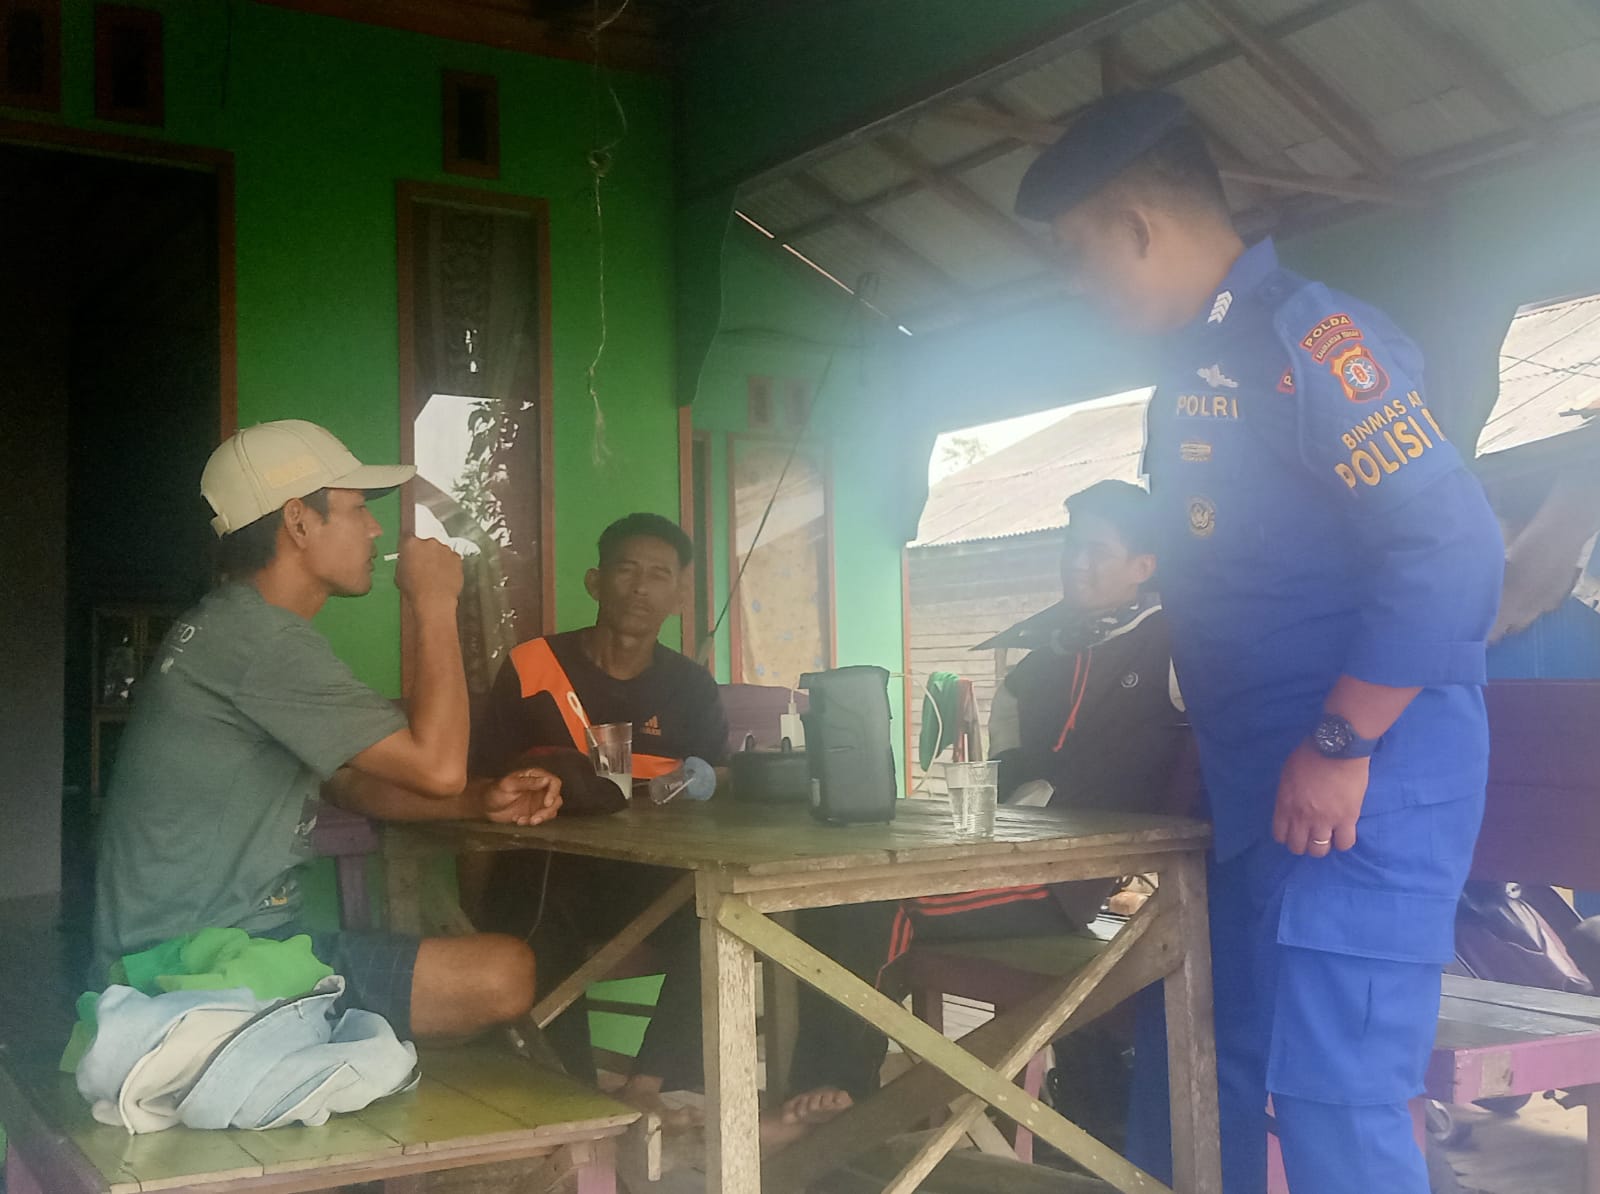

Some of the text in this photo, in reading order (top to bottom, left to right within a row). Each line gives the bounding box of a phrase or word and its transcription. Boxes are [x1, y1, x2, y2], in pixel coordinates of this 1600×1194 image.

[1304, 316, 1351, 347] POLDA
[1176, 394, 1239, 419] POLRI
[1341, 399, 1408, 450] BINMAS
[1334, 415, 1434, 489] POLISI
